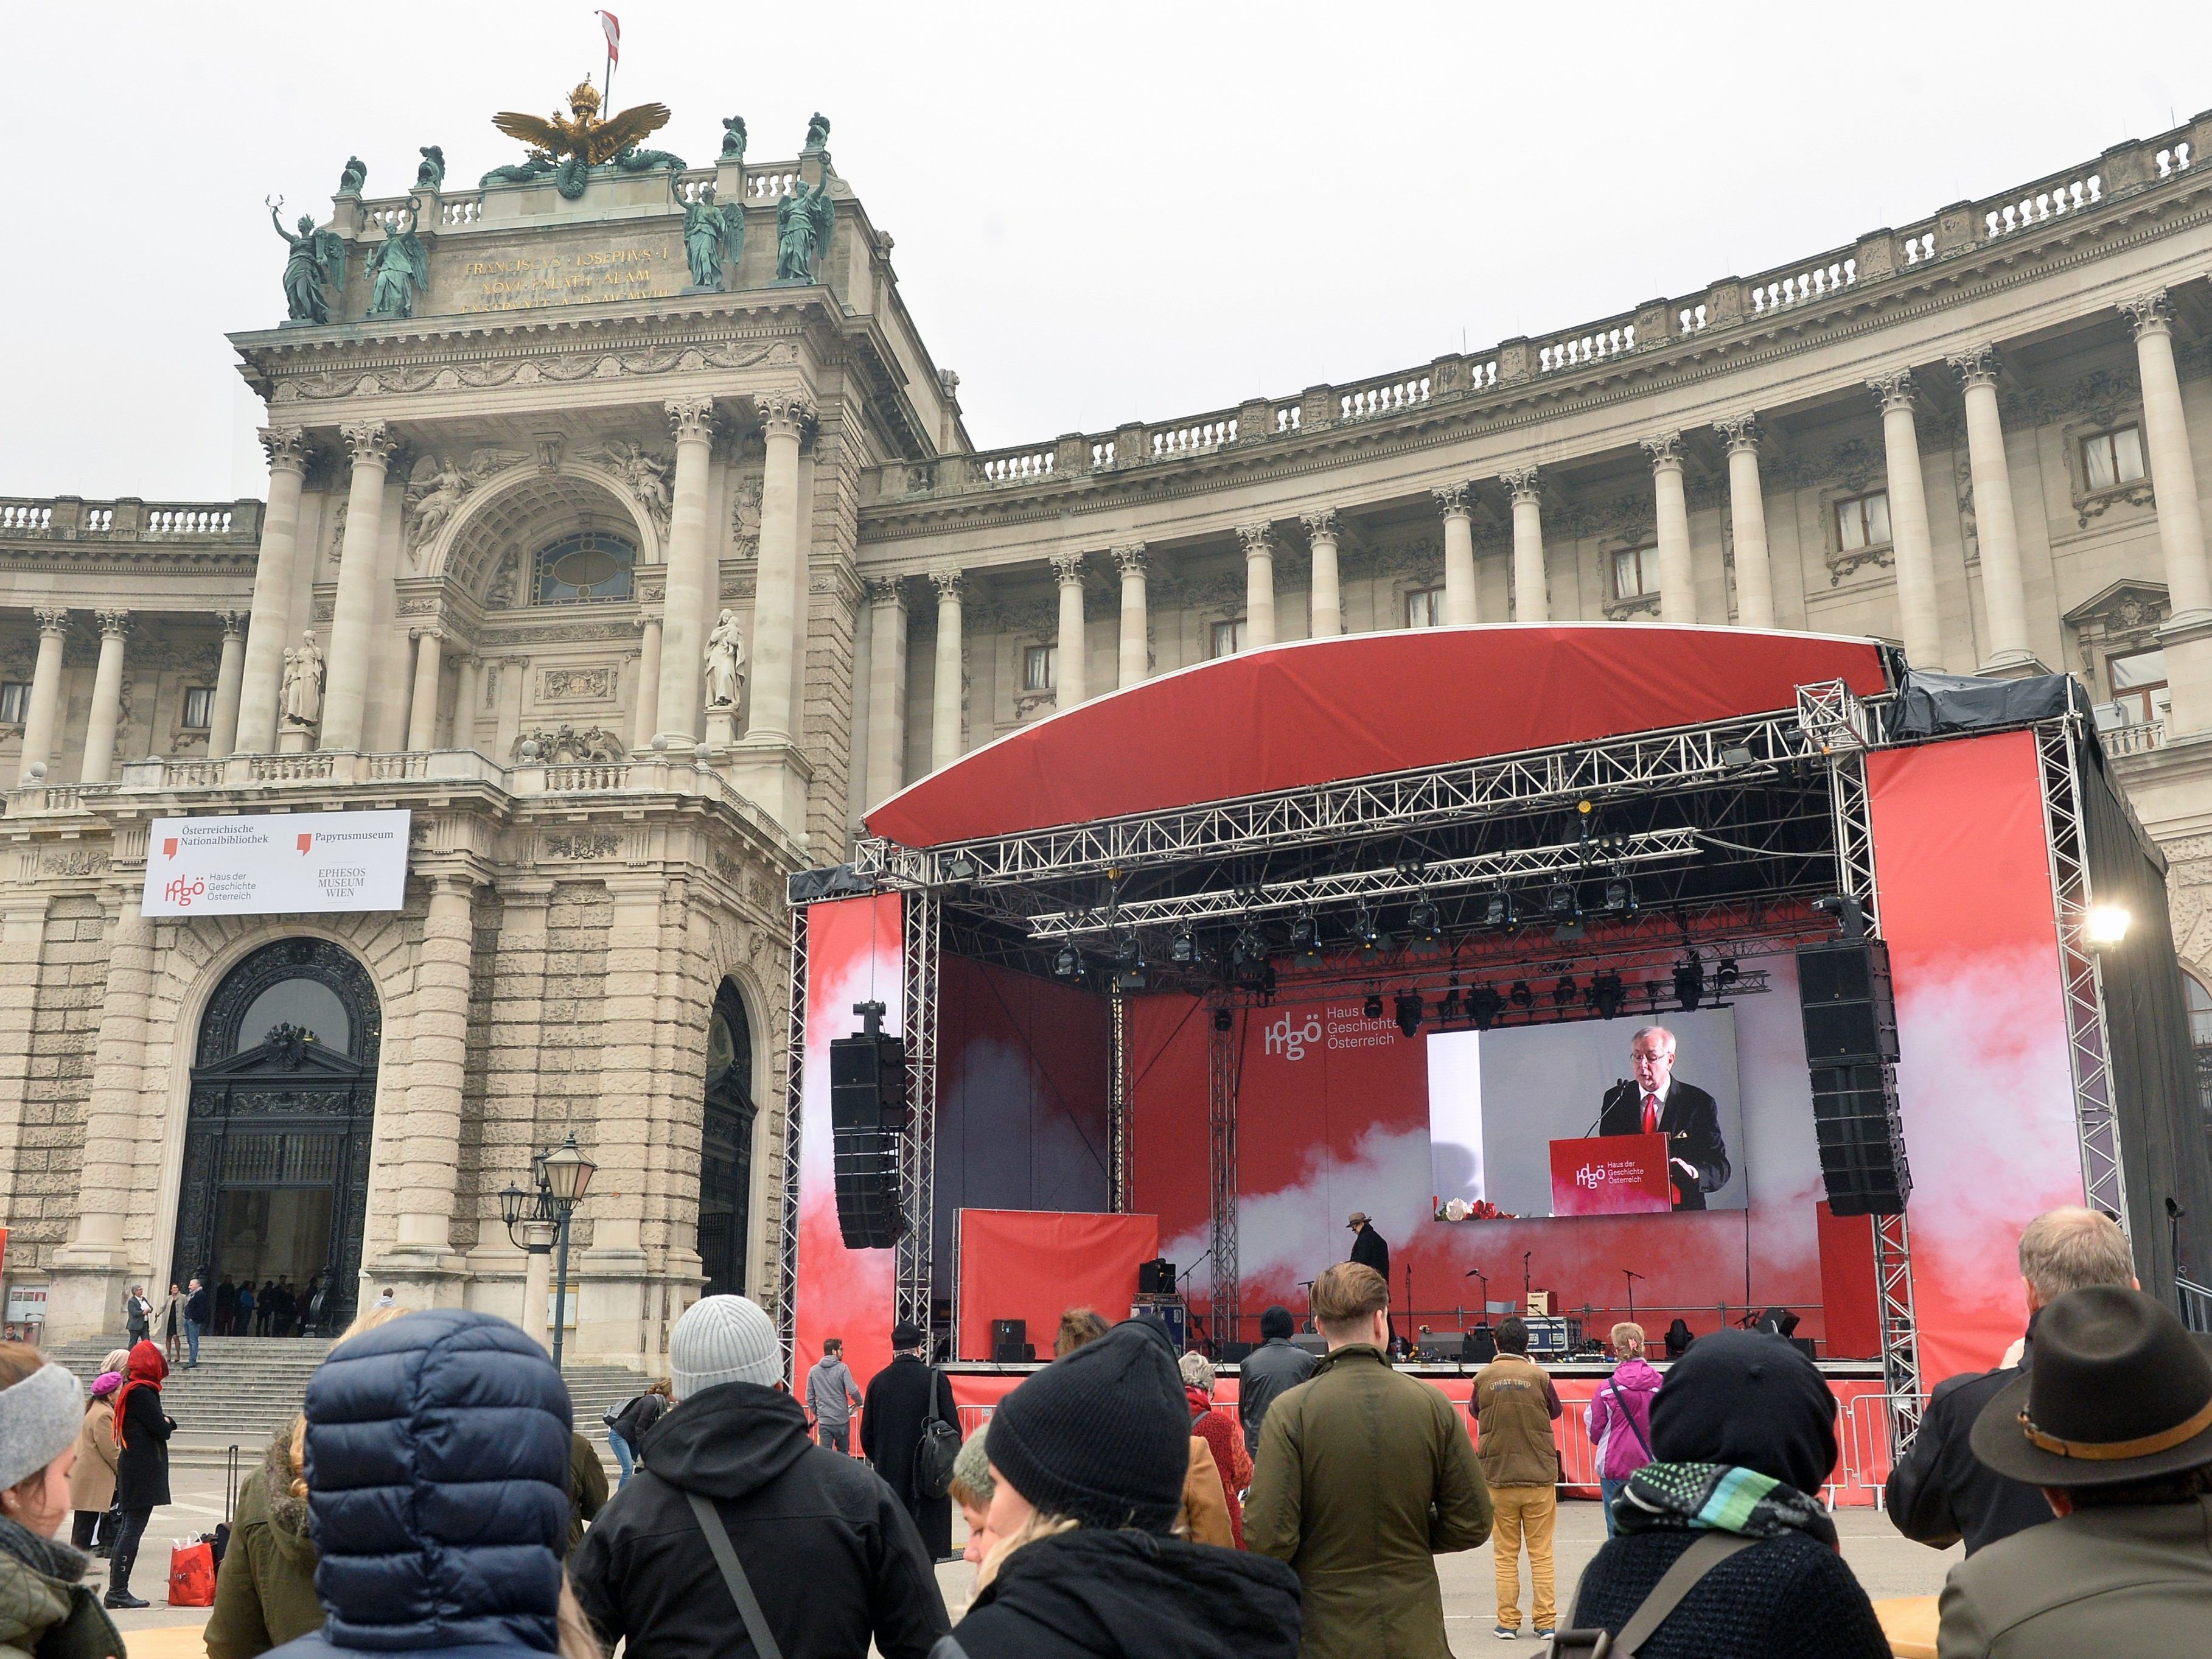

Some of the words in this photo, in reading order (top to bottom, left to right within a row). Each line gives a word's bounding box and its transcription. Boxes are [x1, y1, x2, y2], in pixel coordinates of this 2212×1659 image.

[466, 257, 561, 276] FRANCISCVS
[577, 248, 652, 267] IOSEPHVS
[483, 280, 522, 294] NOVI
[602, 270, 650, 285] ALAM
[182, 825, 254, 835] Österreichische
[181, 834, 269, 846] Nationalbibliothek
[315, 831, 394, 843] Papyrusmuseum
[318, 868, 366, 878] EPHESOS
[208, 882, 256, 891] Geschichte
[318, 878, 365, 888] MUSEUM
[208, 892, 251, 901] Österreich
[326, 888, 355, 897] WIEN
[1327, 1007, 1359, 1019] Haus
[1327, 1018, 1399, 1034] Geschichte
[1328, 1033, 1394, 1049] Österreich
[1490, 1378, 1512, 1391] GREAT
